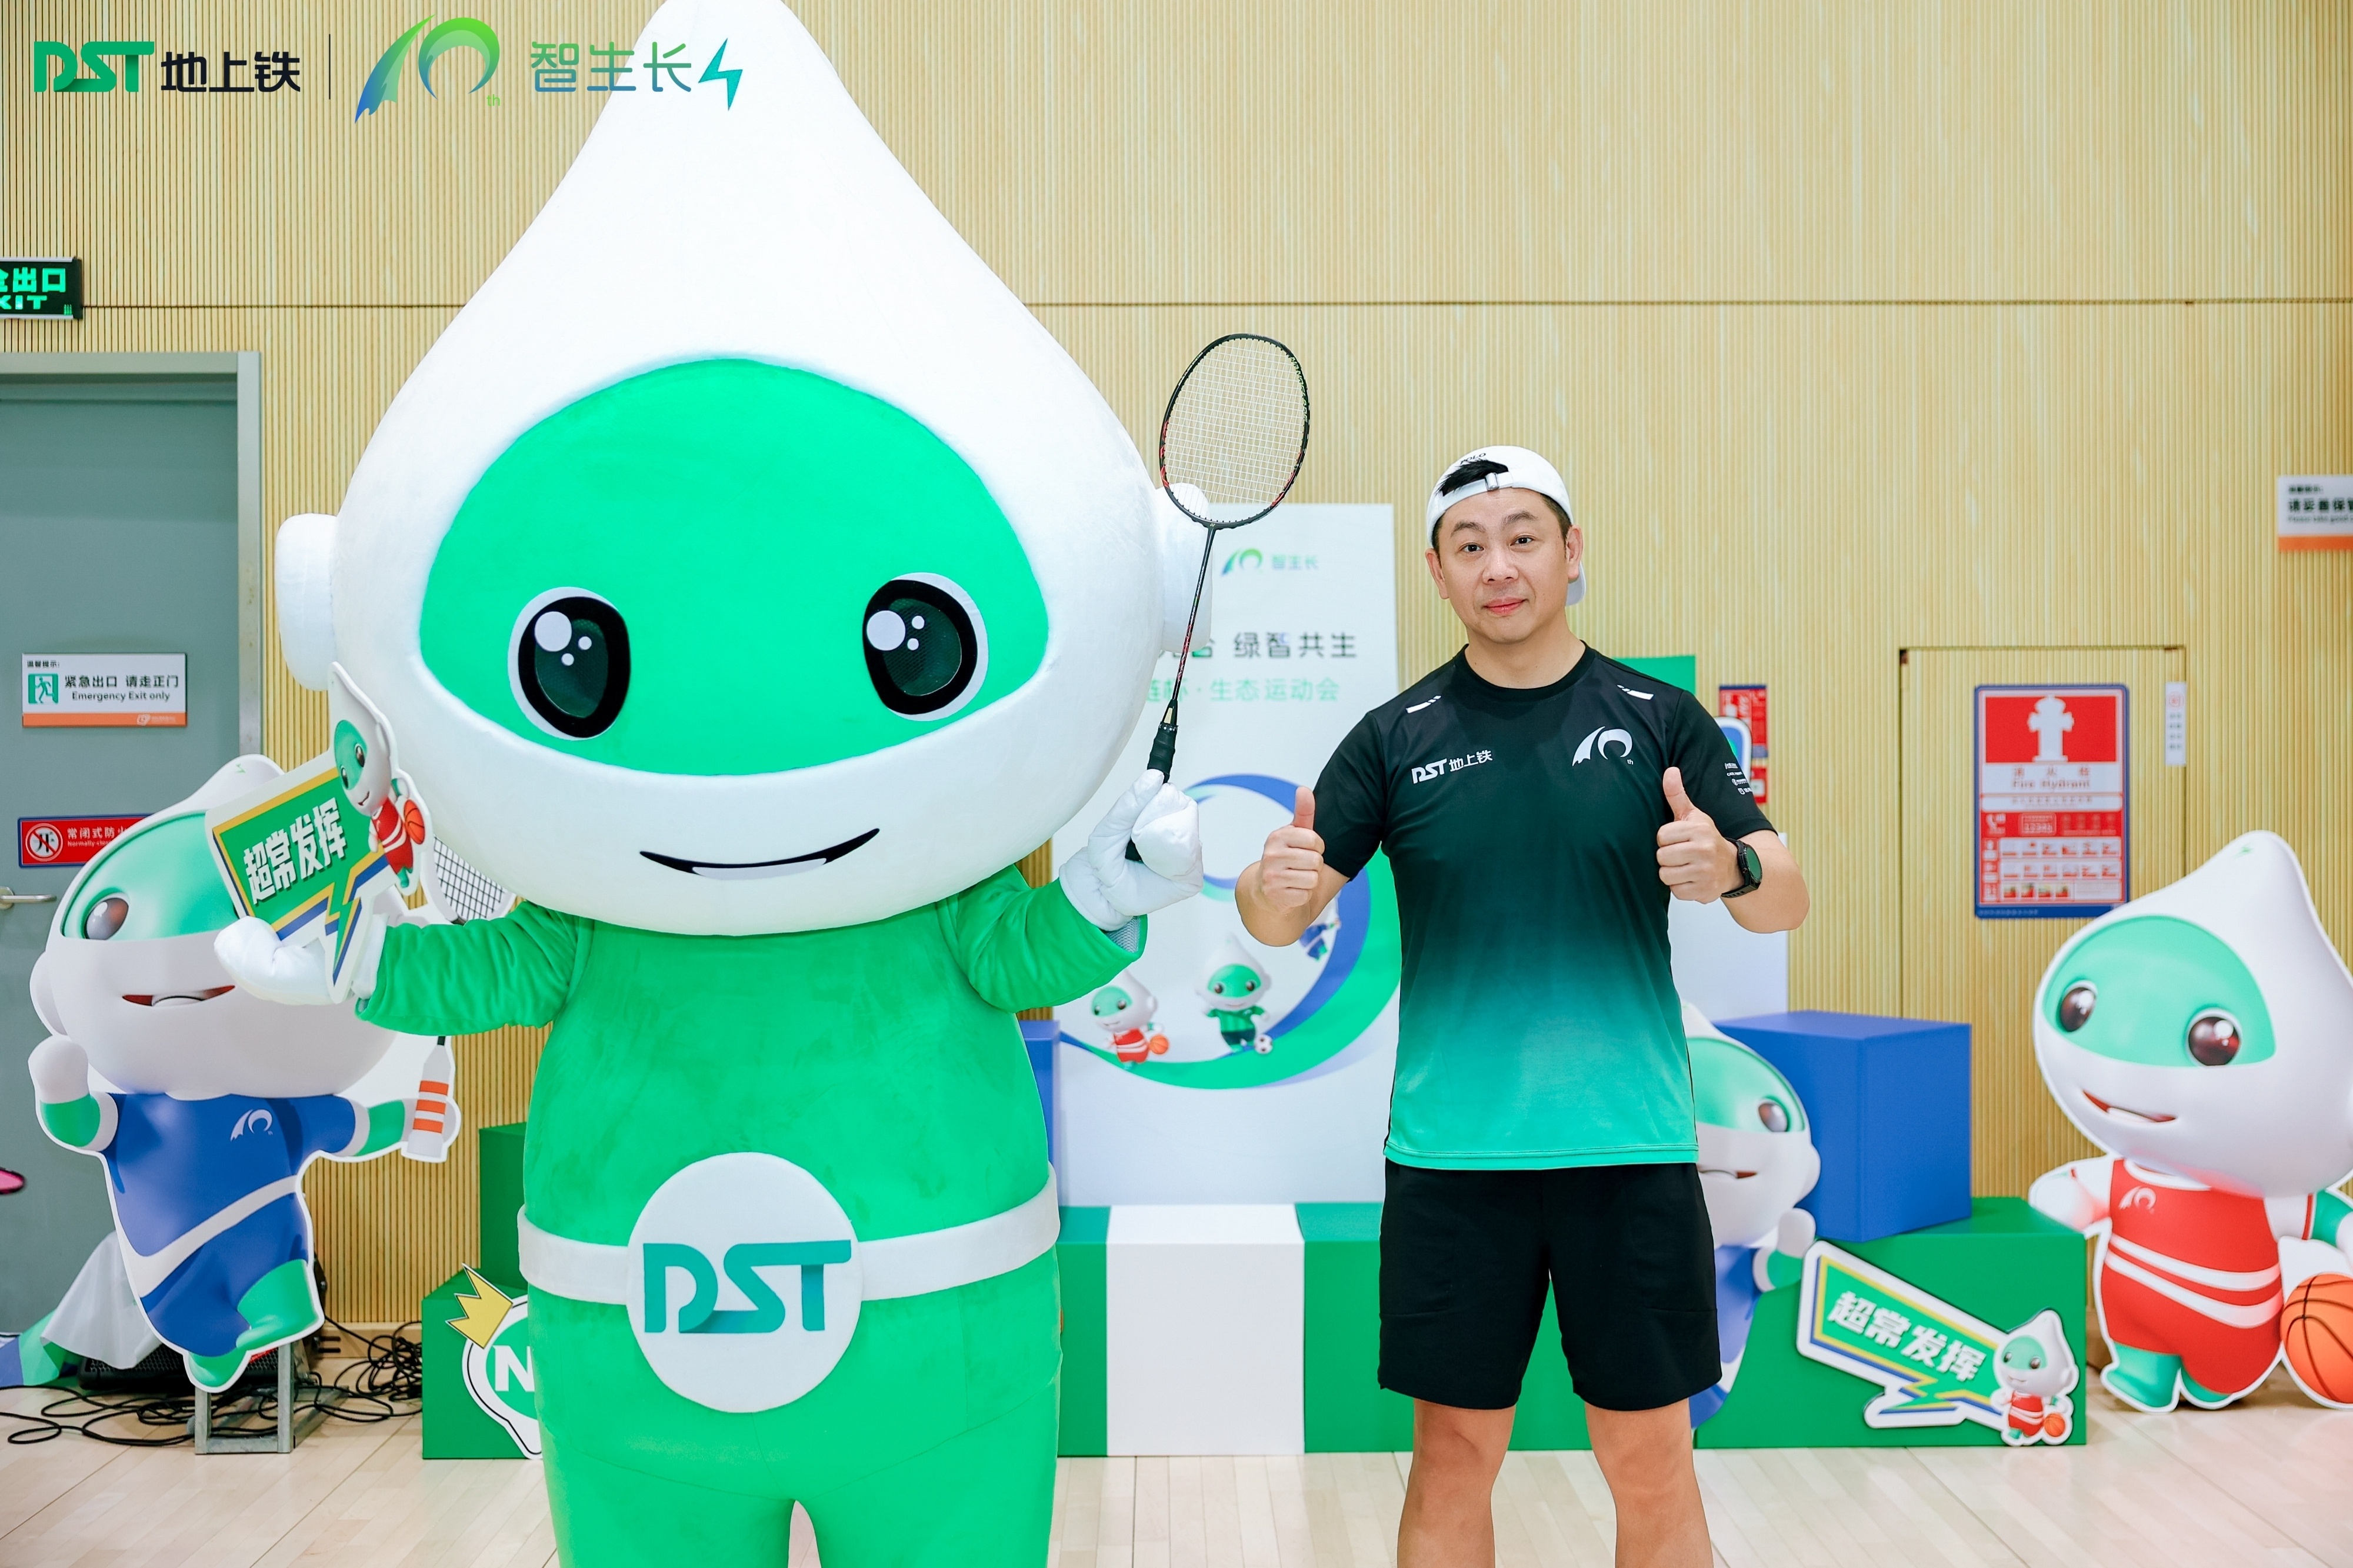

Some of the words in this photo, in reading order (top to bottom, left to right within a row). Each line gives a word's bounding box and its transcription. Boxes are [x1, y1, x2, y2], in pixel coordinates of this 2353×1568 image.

[1234, 632, 1356, 658] 绿智共生
[65, 675, 117, 688] 紧急出口
[126, 675, 178, 688] 请走正门
[72, 691, 125, 702] Emergency
[129, 691, 146, 699] Exit
[149, 691, 170, 702] only
[1411, 758, 1447, 784] DST
[1449, 750, 1493, 772] 地上铁
[243, 797, 347, 906] 超常发挥
[643, 1240, 852, 1333] DST
[1828, 1291, 1987, 1382] 超常发挥
